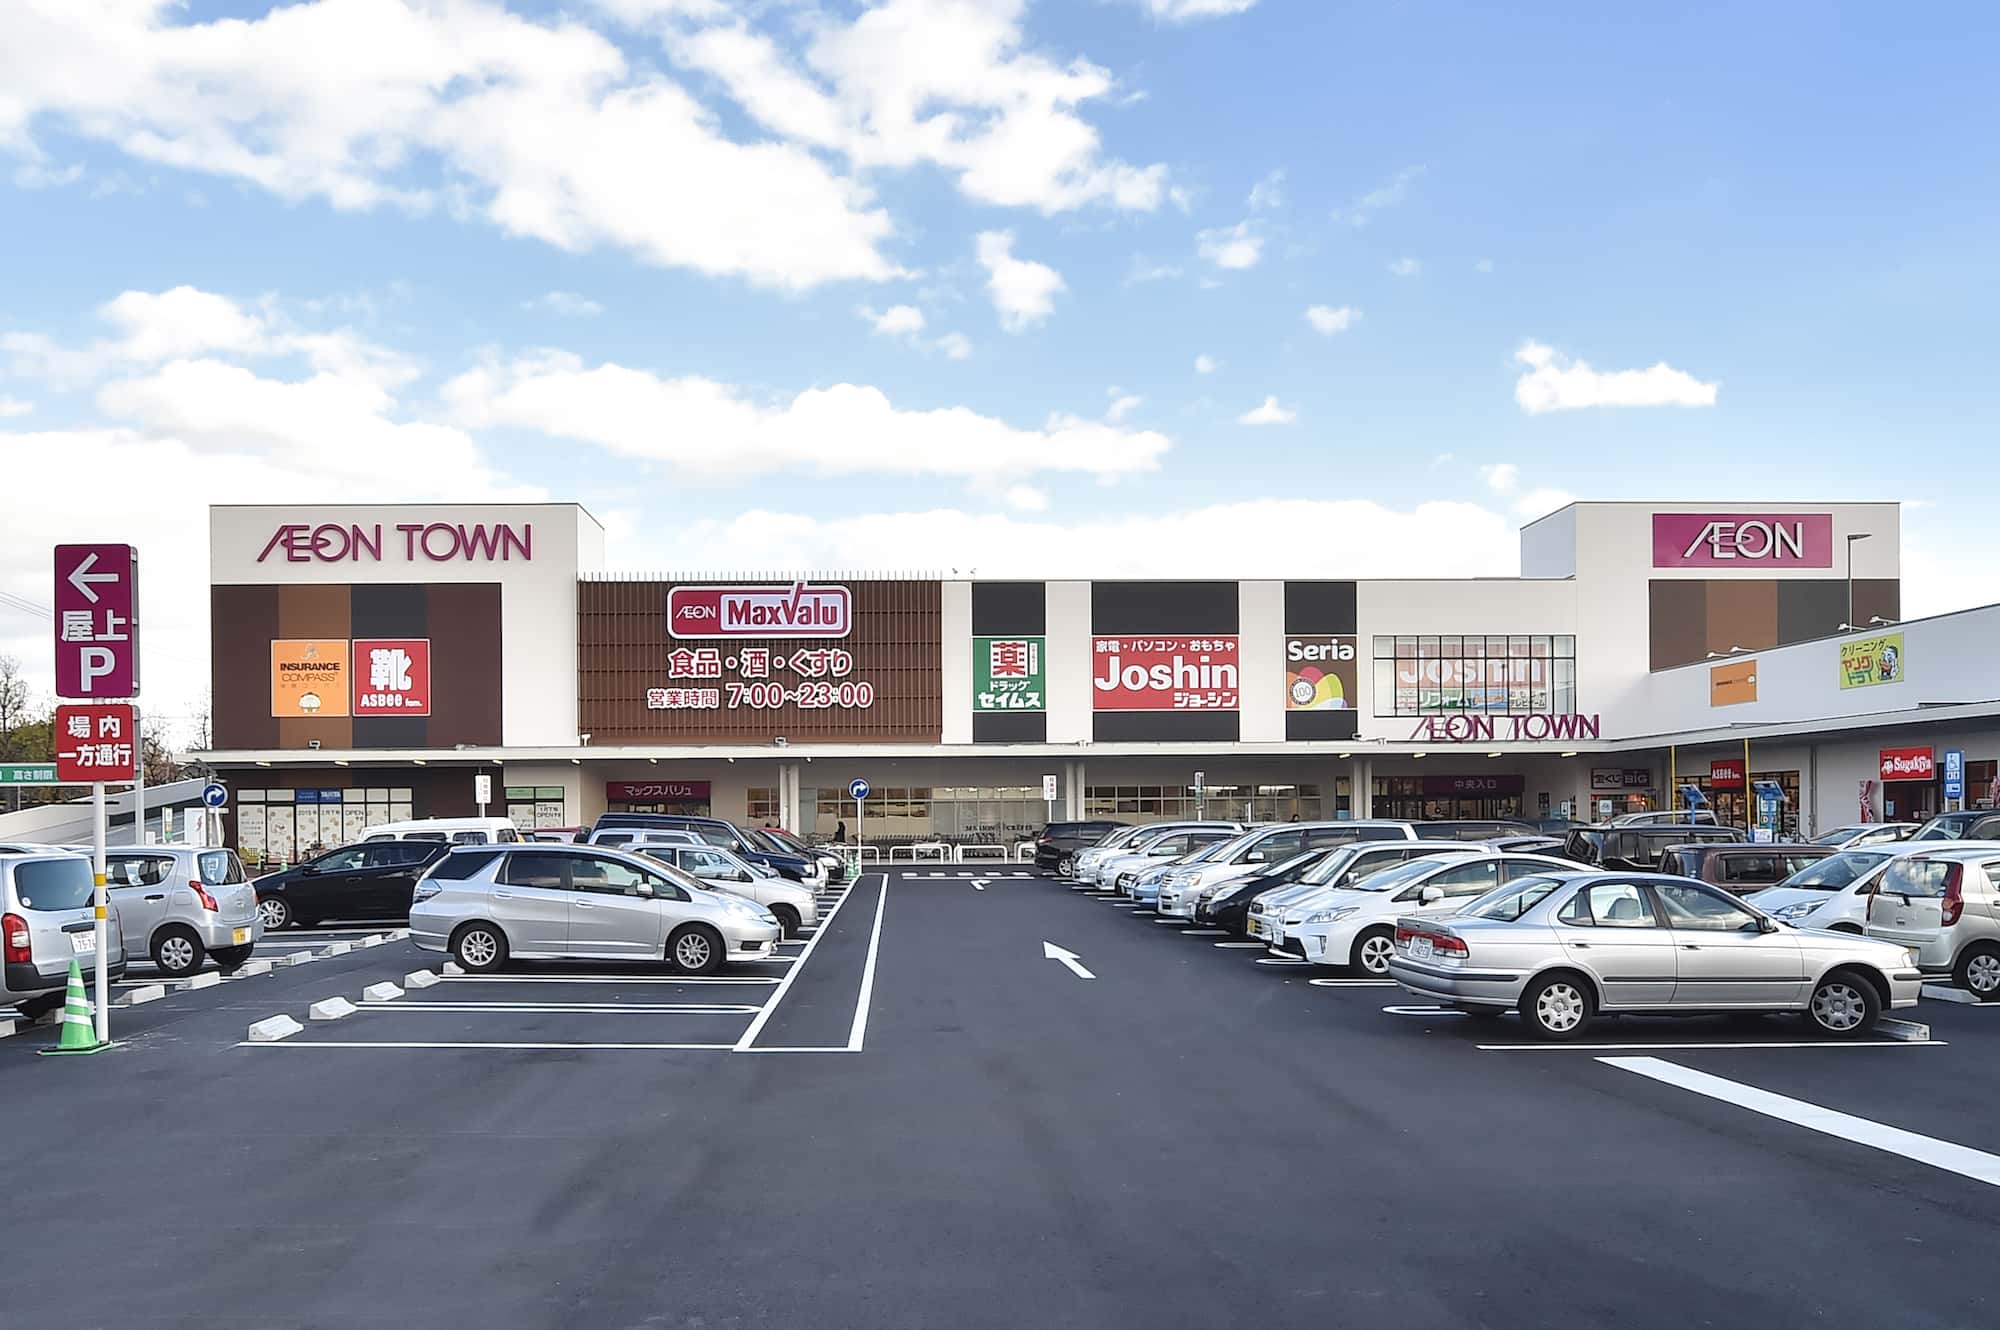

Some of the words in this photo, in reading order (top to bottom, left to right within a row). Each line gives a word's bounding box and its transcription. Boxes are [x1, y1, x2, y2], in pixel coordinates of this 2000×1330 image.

[396, 522, 532, 562] TOWN
[727, 583, 838, 626] MaxValu
[60, 609, 129, 642] 屋上
[667, 648, 852, 678] 食品・酒・くすり
[991, 641, 1027, 677] 薬
[1287, 639, 1355, 661] Seria
[80, 646, 116, 693] P
[280, 662, 341, 672] INSURANCE
[369, 648, 414, 692] 靴
[1094, 655, 1238, 691] Joshin
[1399, 647, 1541, 684] Joshin
[647, 688, 719, 709] 営業時間
[978, 691, 1041, 708] セイムス
[990, 680, 1031, 692] ドラッグ
[1173, 691, 1237, 708] ジョーシン
[1509, 713, 1600, 741] TOWN
[58, 744, 132, 767] 一方通行
[623, 785, 693, 797] マックスバリュ
